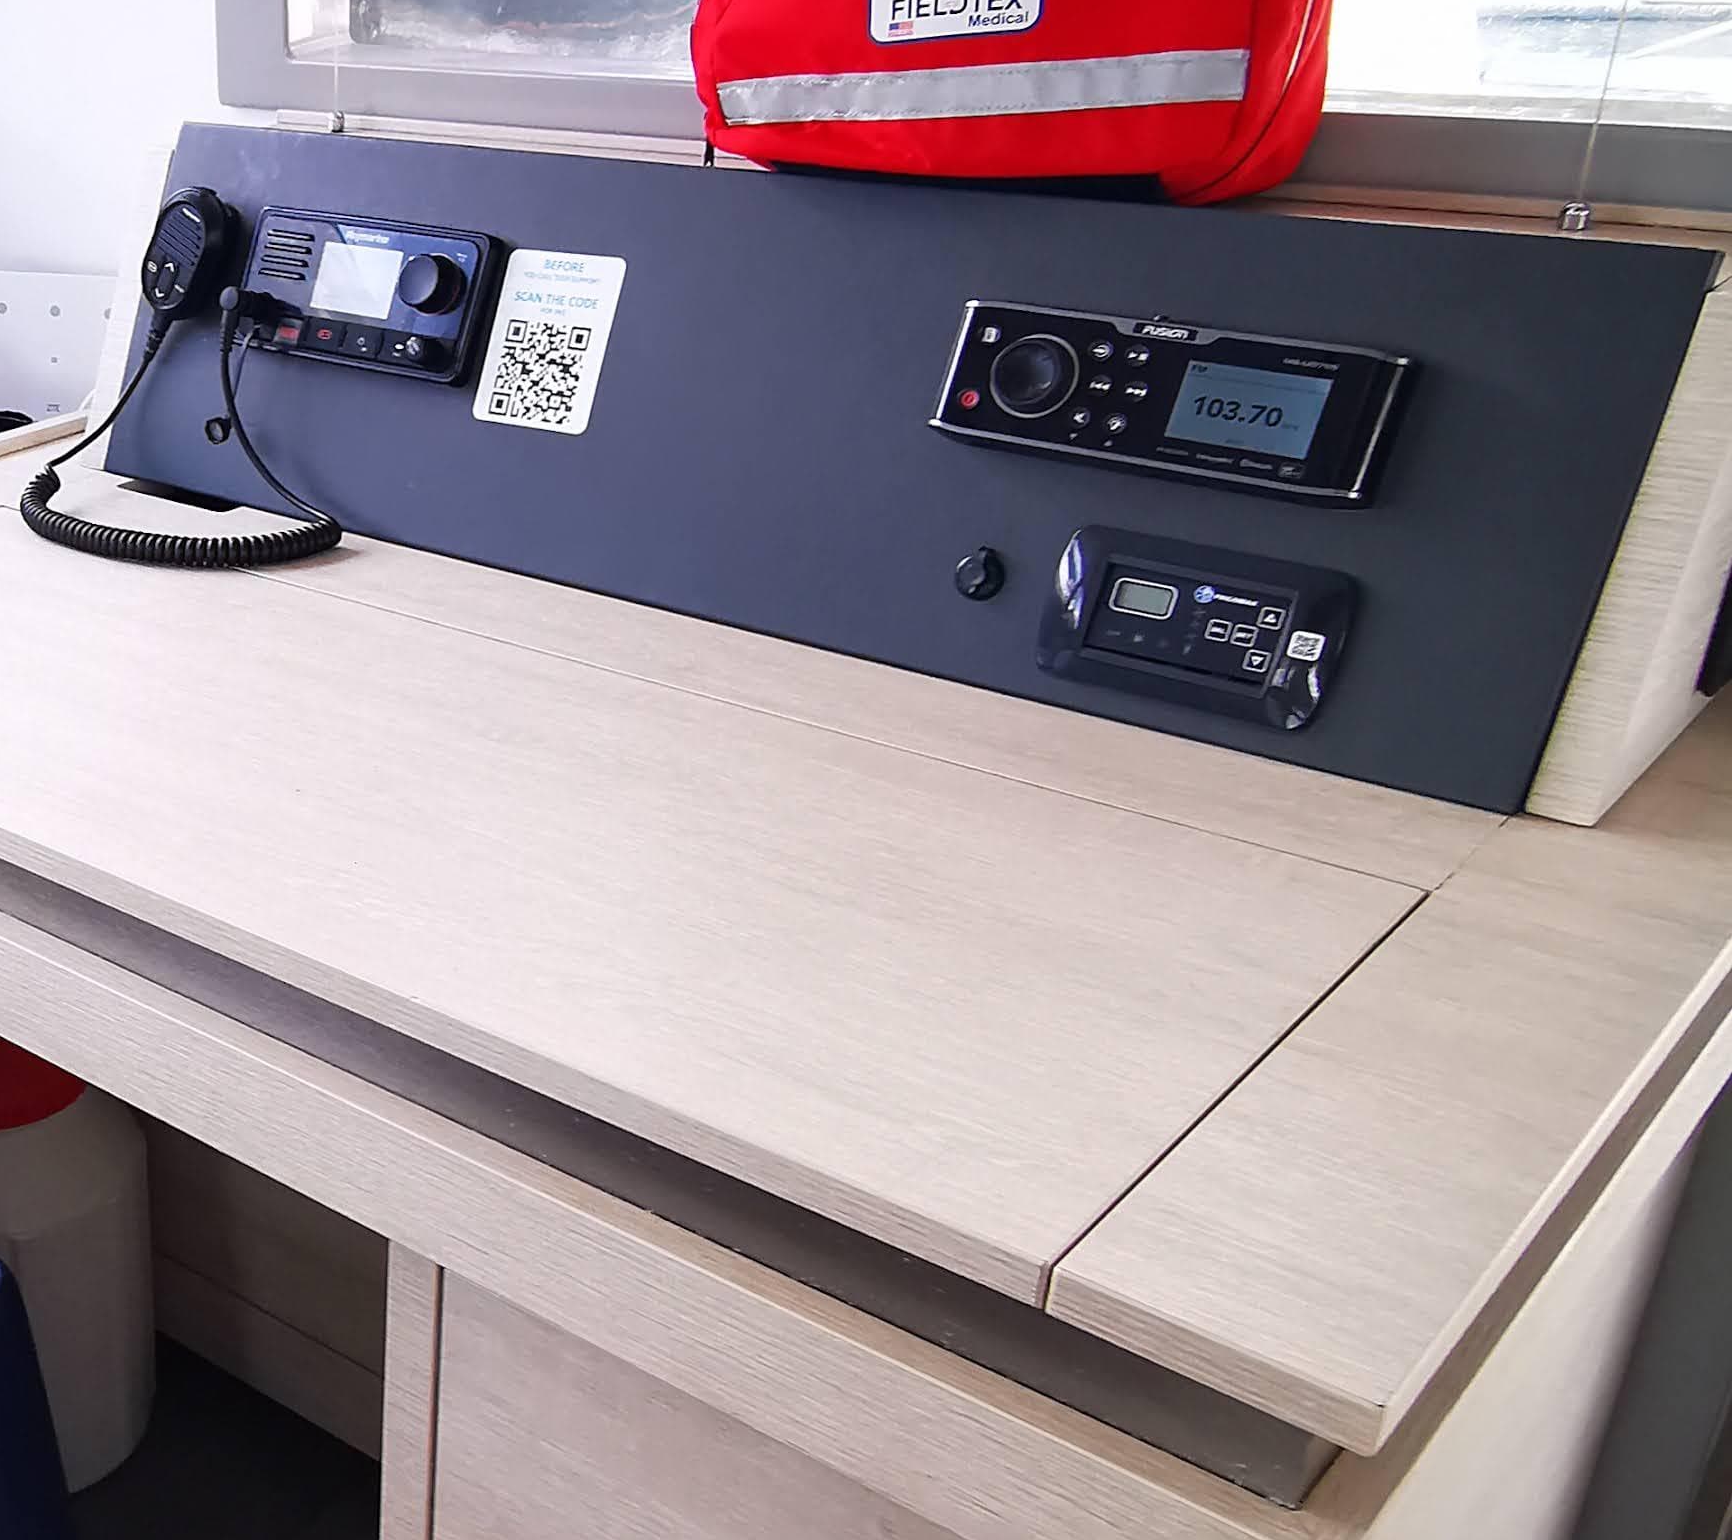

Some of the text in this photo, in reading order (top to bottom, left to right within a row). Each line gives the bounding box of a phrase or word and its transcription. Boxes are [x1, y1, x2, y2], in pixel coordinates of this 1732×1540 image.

[968, 11, 1029, 28] Medical
[514, 291, 599, 310] SCAN THE CODE
[1194, 396, 1284, 428] 103.70
